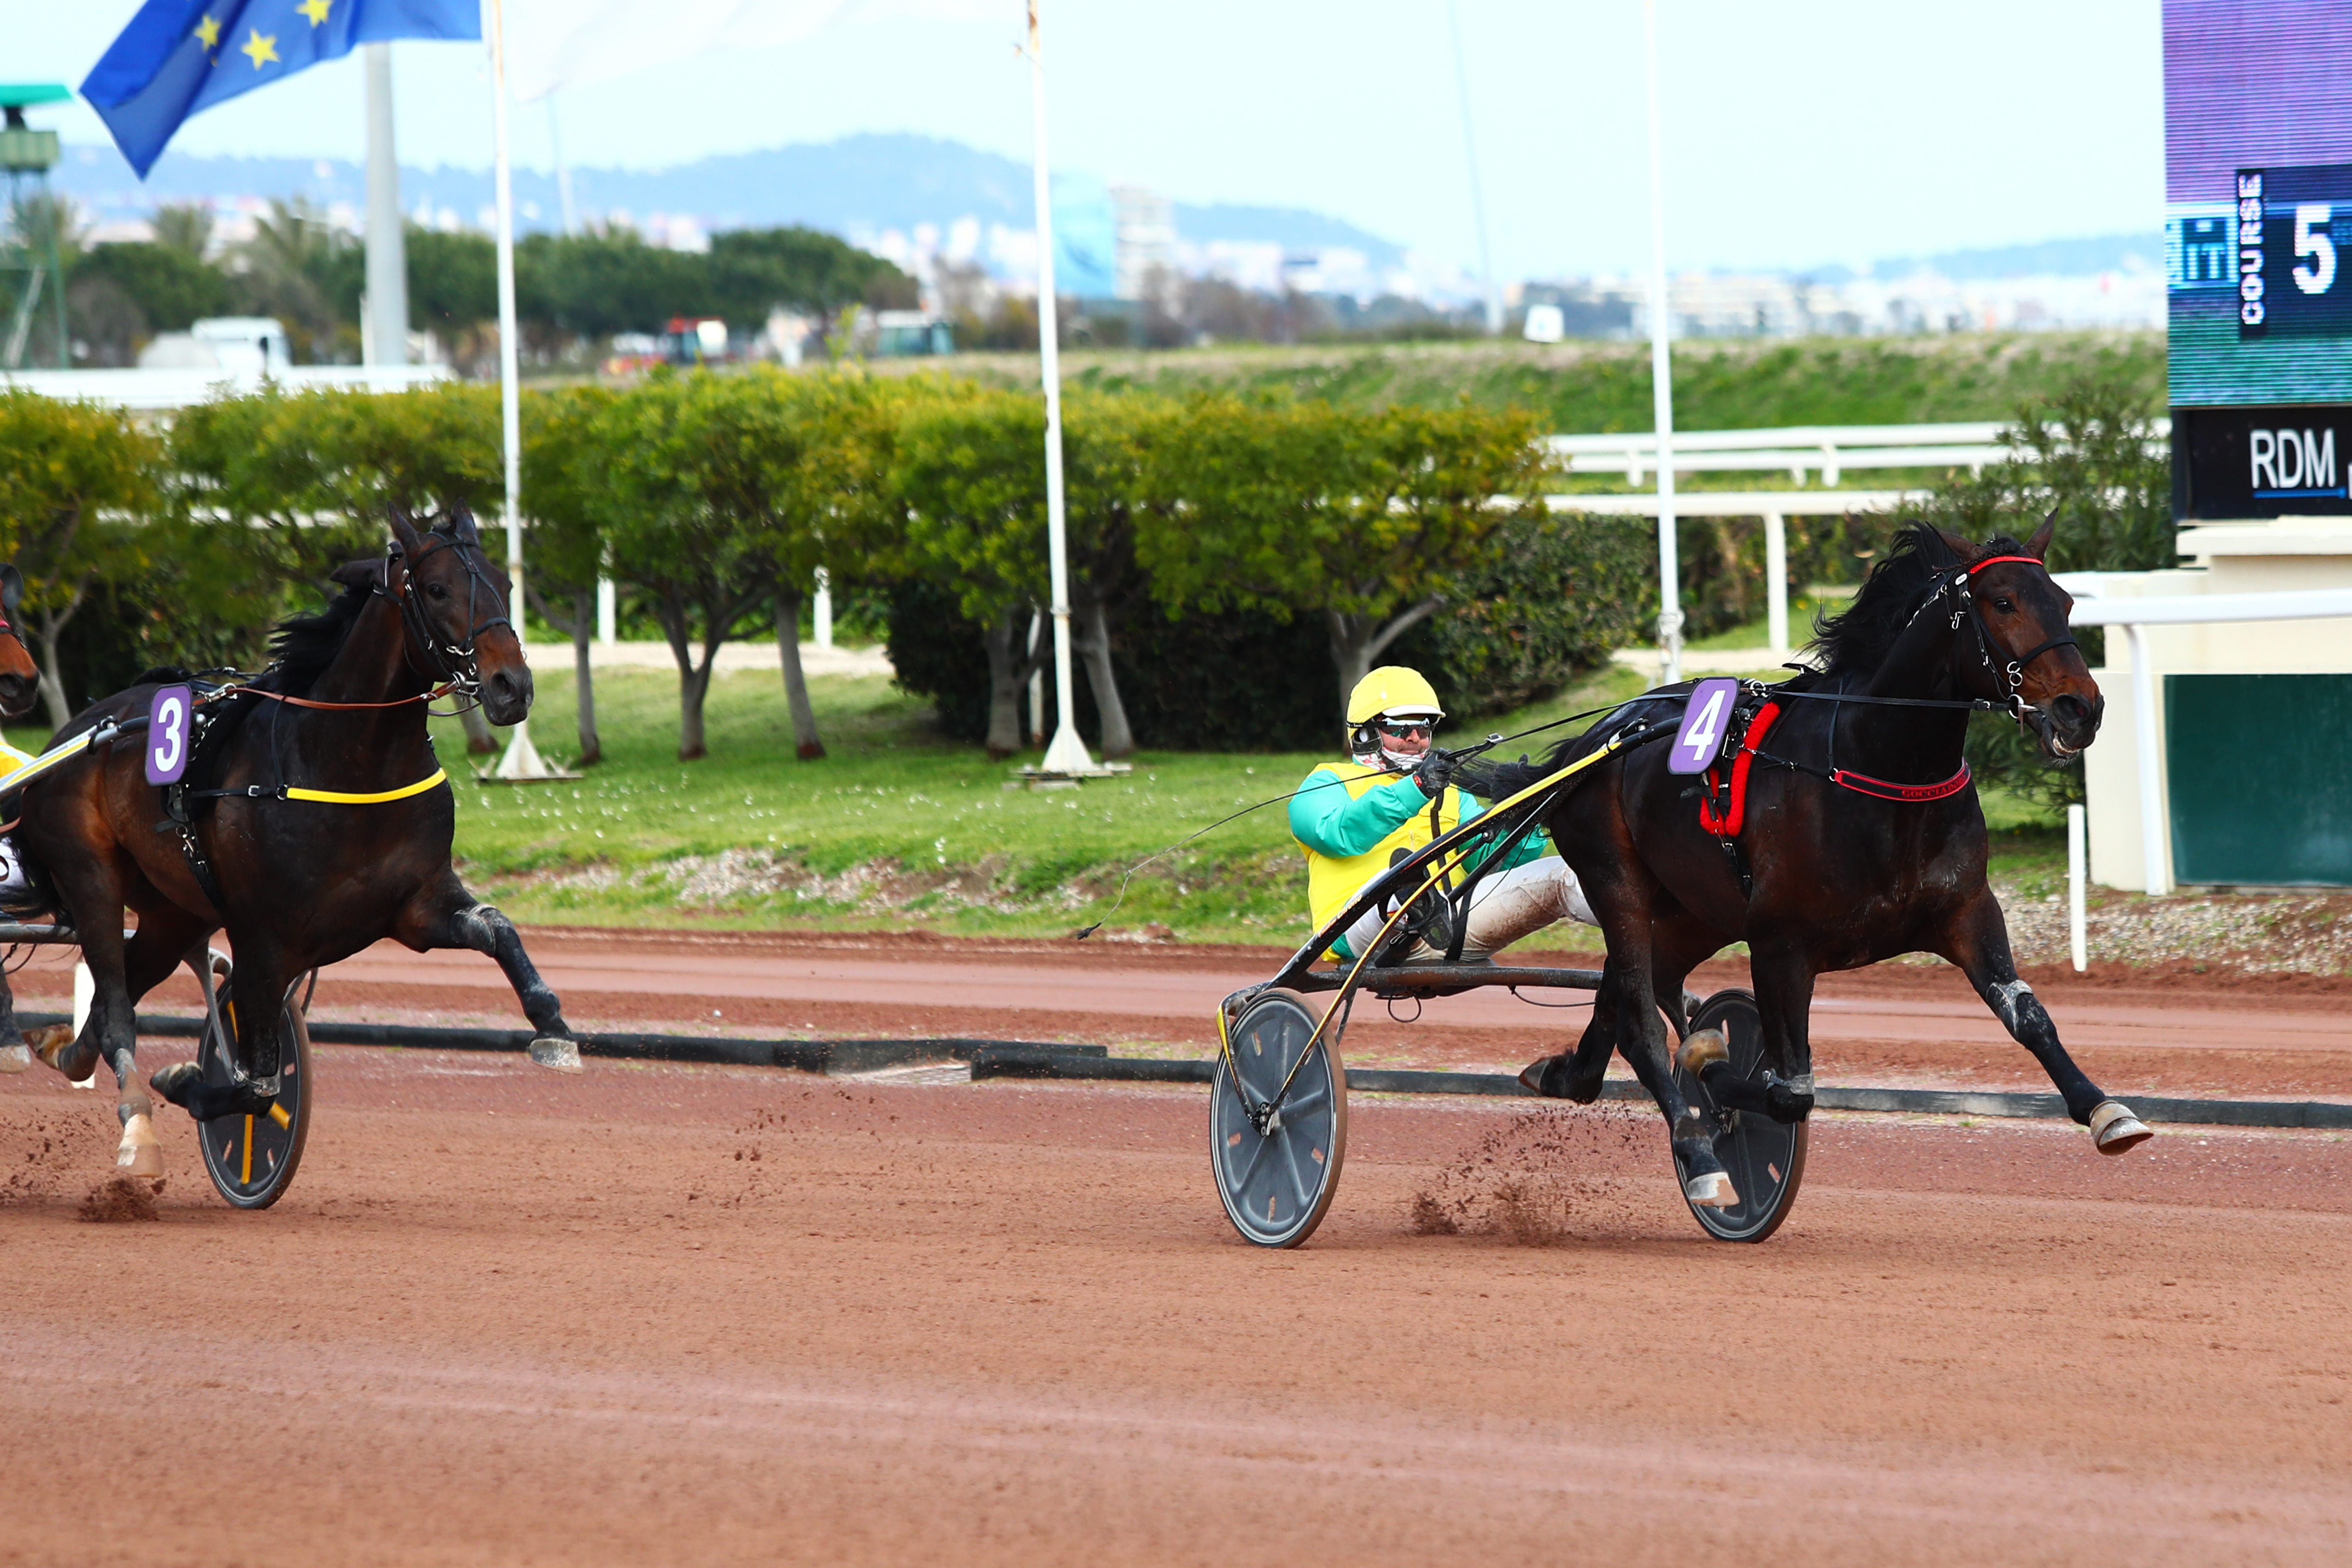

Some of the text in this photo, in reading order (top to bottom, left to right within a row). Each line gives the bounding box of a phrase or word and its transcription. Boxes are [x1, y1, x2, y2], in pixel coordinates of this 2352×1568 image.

[2238, 174, 2265, 325] COURSE
[2292, 205, 2337, 294] 5
[2250, 429, 2336, 489] RDM
[154, 697, 183, 772] 3
[1682, 689, 1726, 761] 4
